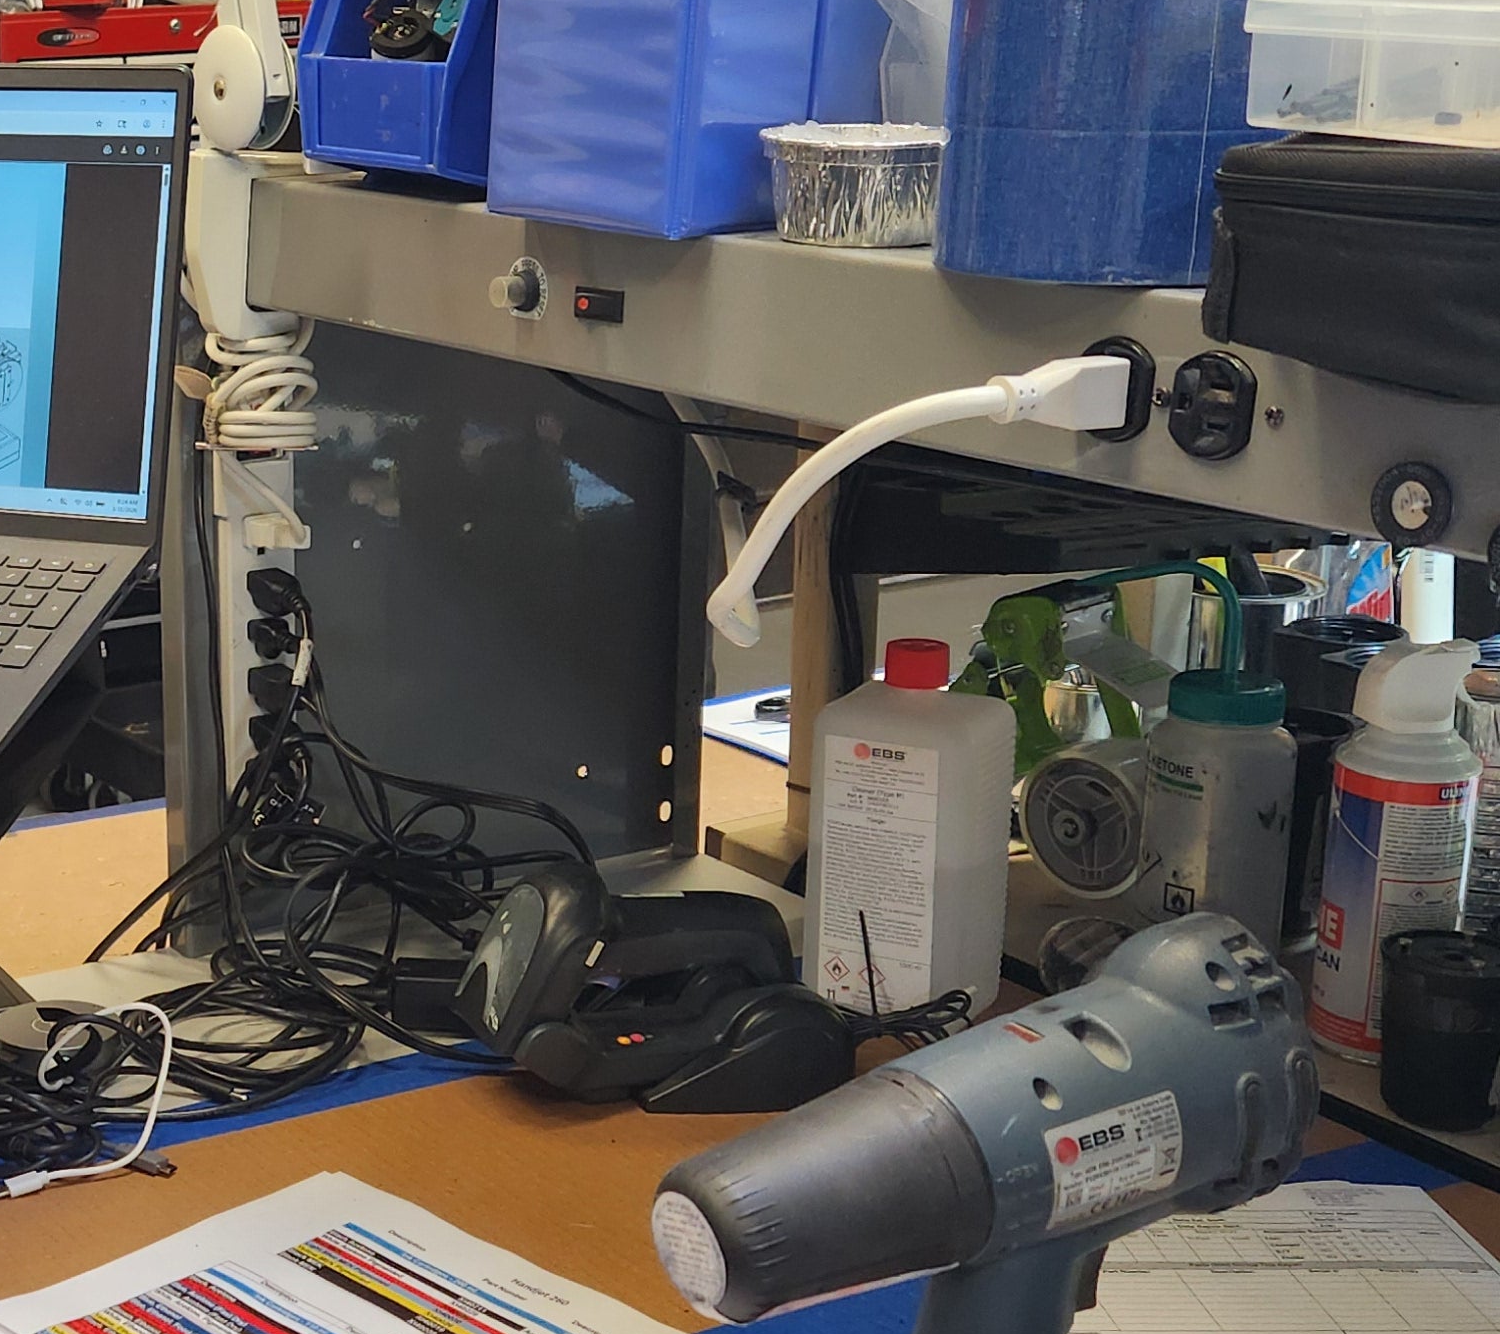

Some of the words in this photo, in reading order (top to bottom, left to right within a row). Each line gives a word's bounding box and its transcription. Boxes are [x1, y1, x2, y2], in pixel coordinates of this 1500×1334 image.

[872, 748, 905, 760] EBS
[1078, 1124, 1125, 1151] EBS
[388, 1229, 426, 1252] Description
[482, 1277, 500, 1289] Part
[500, 1286, 528, 1302] Number
[510, 1277, 550, 1300] Handjet
[549, 1294, 571, 1307] 260
